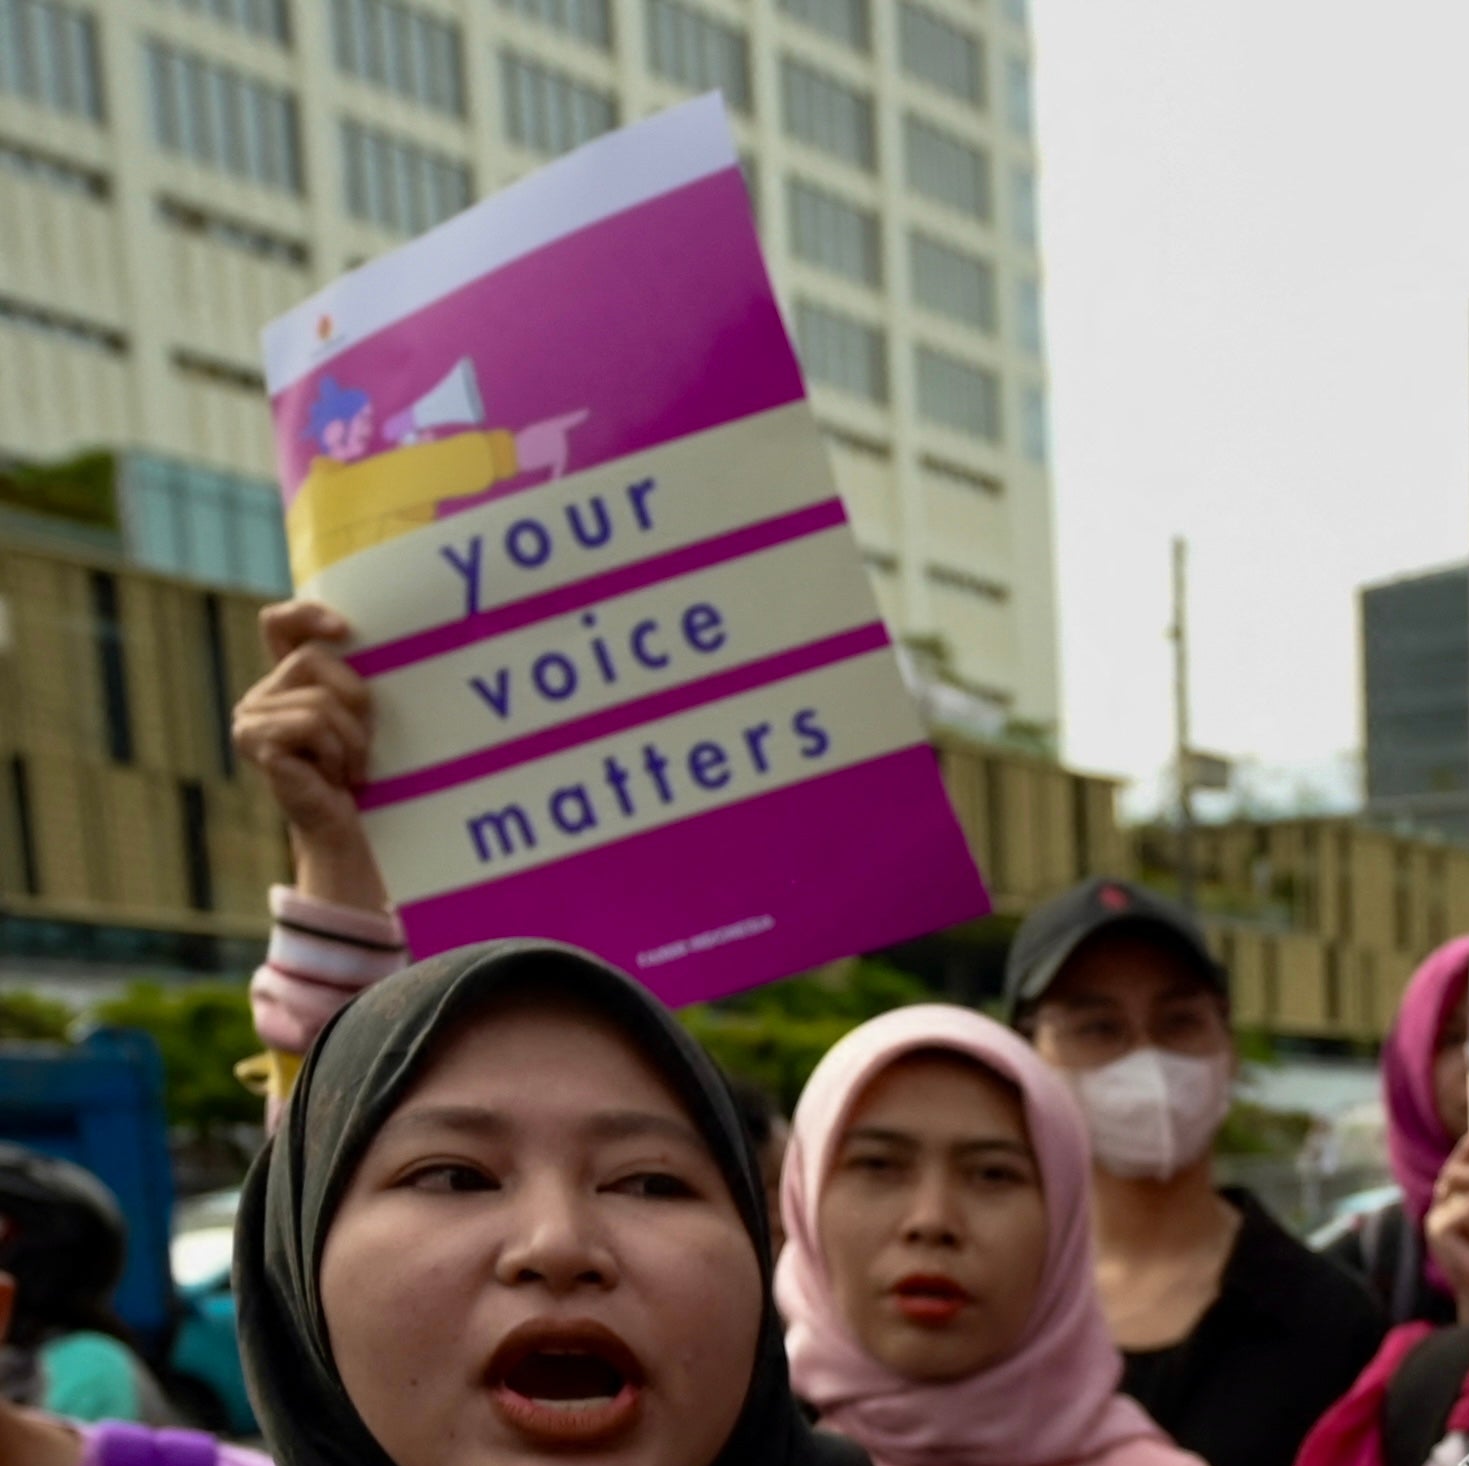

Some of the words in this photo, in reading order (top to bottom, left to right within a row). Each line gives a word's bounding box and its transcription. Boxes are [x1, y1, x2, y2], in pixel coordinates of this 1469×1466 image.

[438, 475, 657, 617] your
[468, 602, 727, 720] voice
[466, 707, 831, 863] matters
